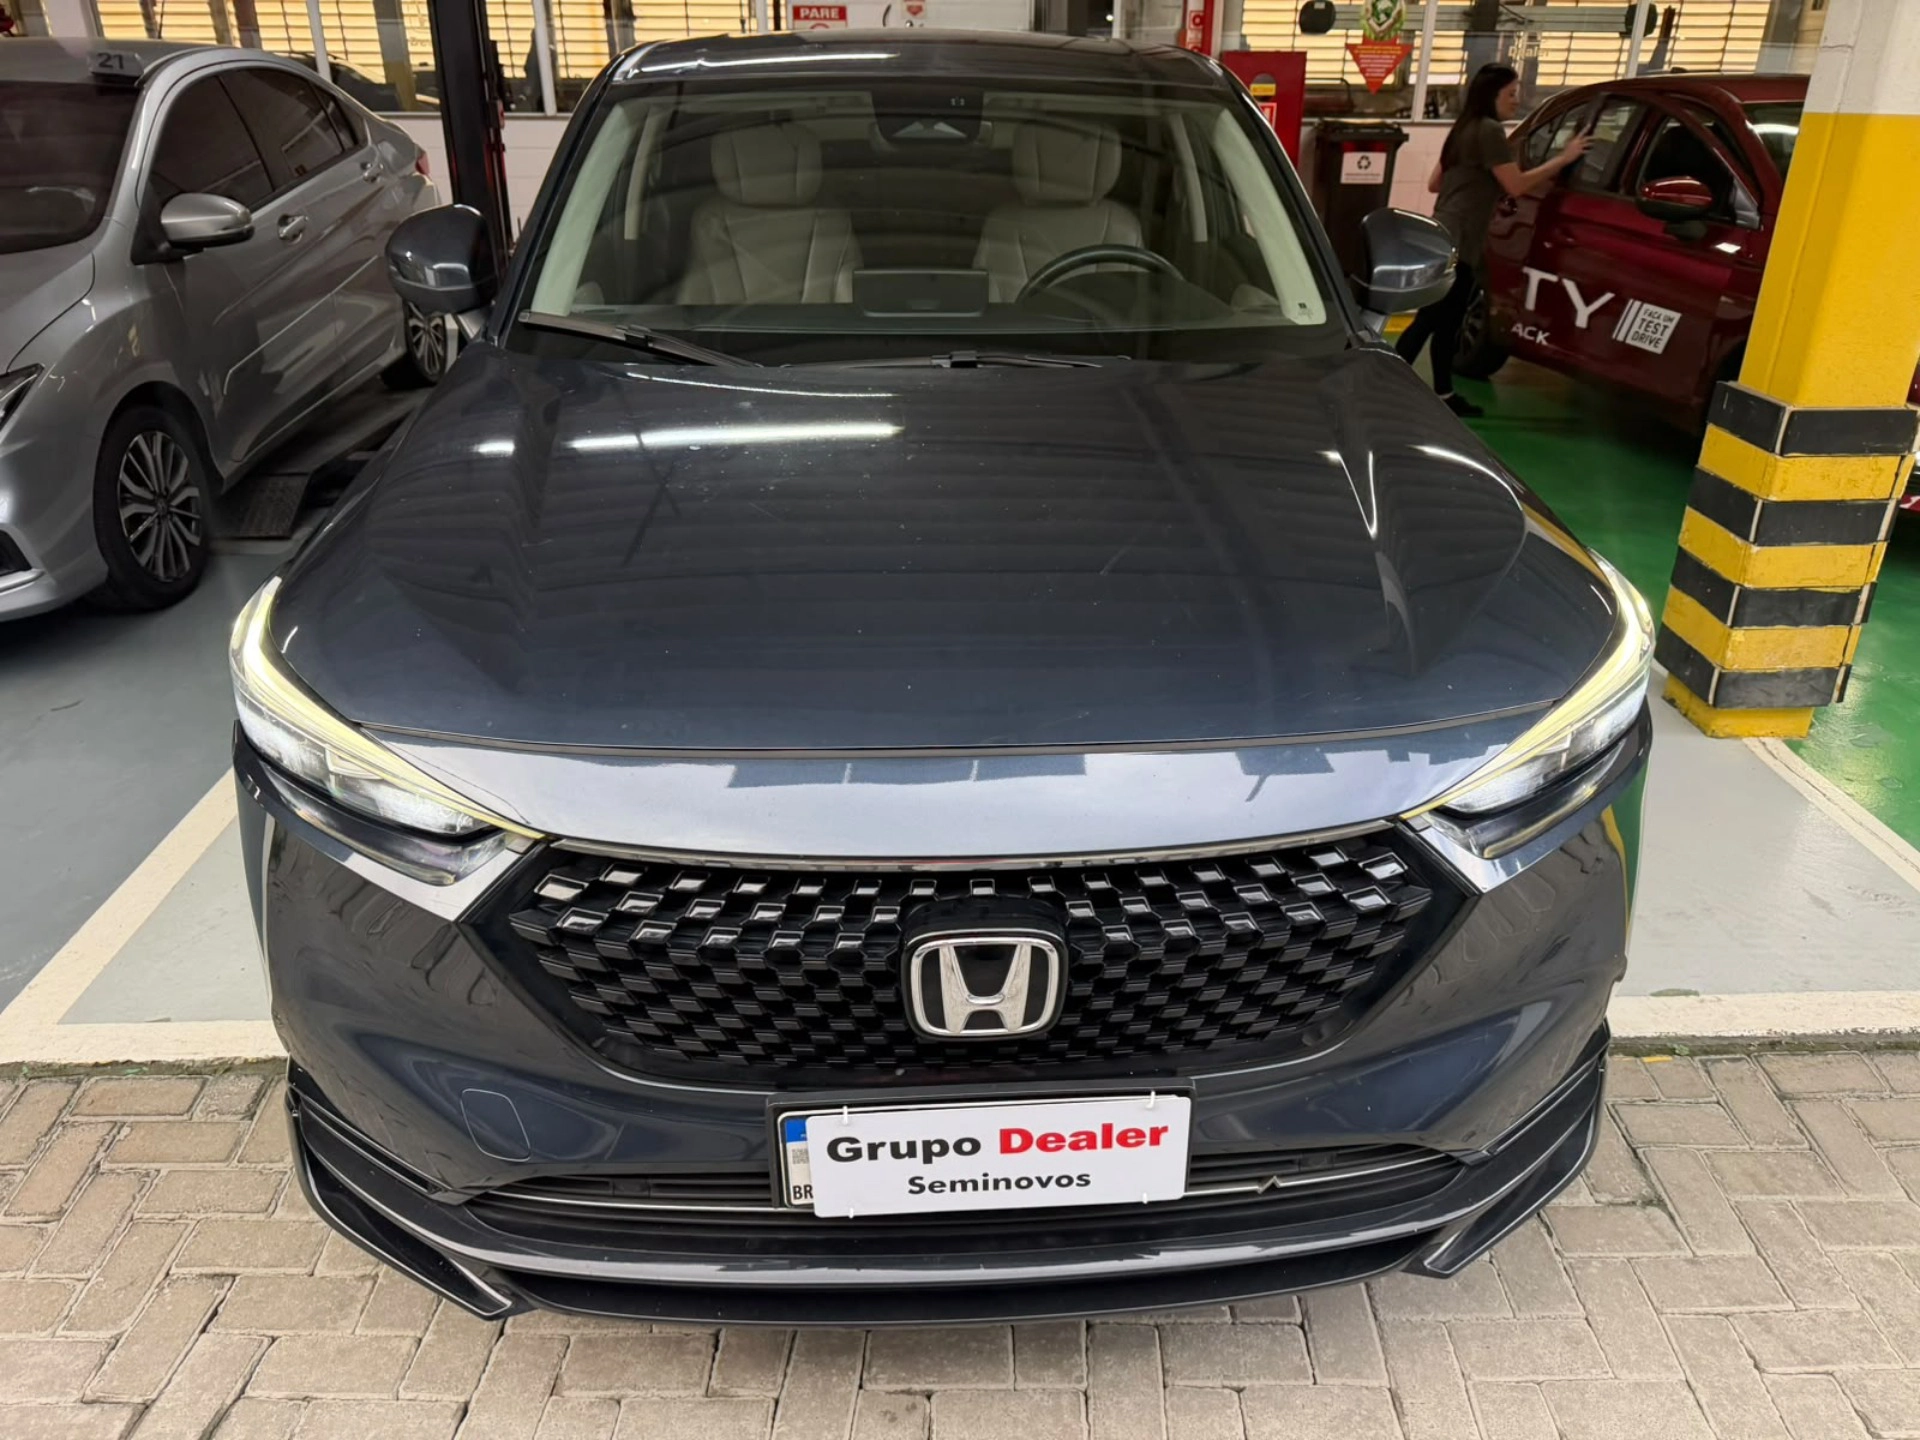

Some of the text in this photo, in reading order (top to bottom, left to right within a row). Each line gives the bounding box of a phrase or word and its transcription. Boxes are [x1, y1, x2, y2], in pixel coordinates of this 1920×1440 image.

[800, 7, 839, 19] PARE
[97, 52, 125, 70] 21
[1521, 266, 1616, 329] TY
[1638, 318, 1670, 336] TEST
[1631, 330, 1663, 348] DRIVE
[825, 1122, 1169, 1164] Grupo Dealer
[792, 1184, 814, 1200] BR
[907, 1172, 1092, 1195] Seminovos
